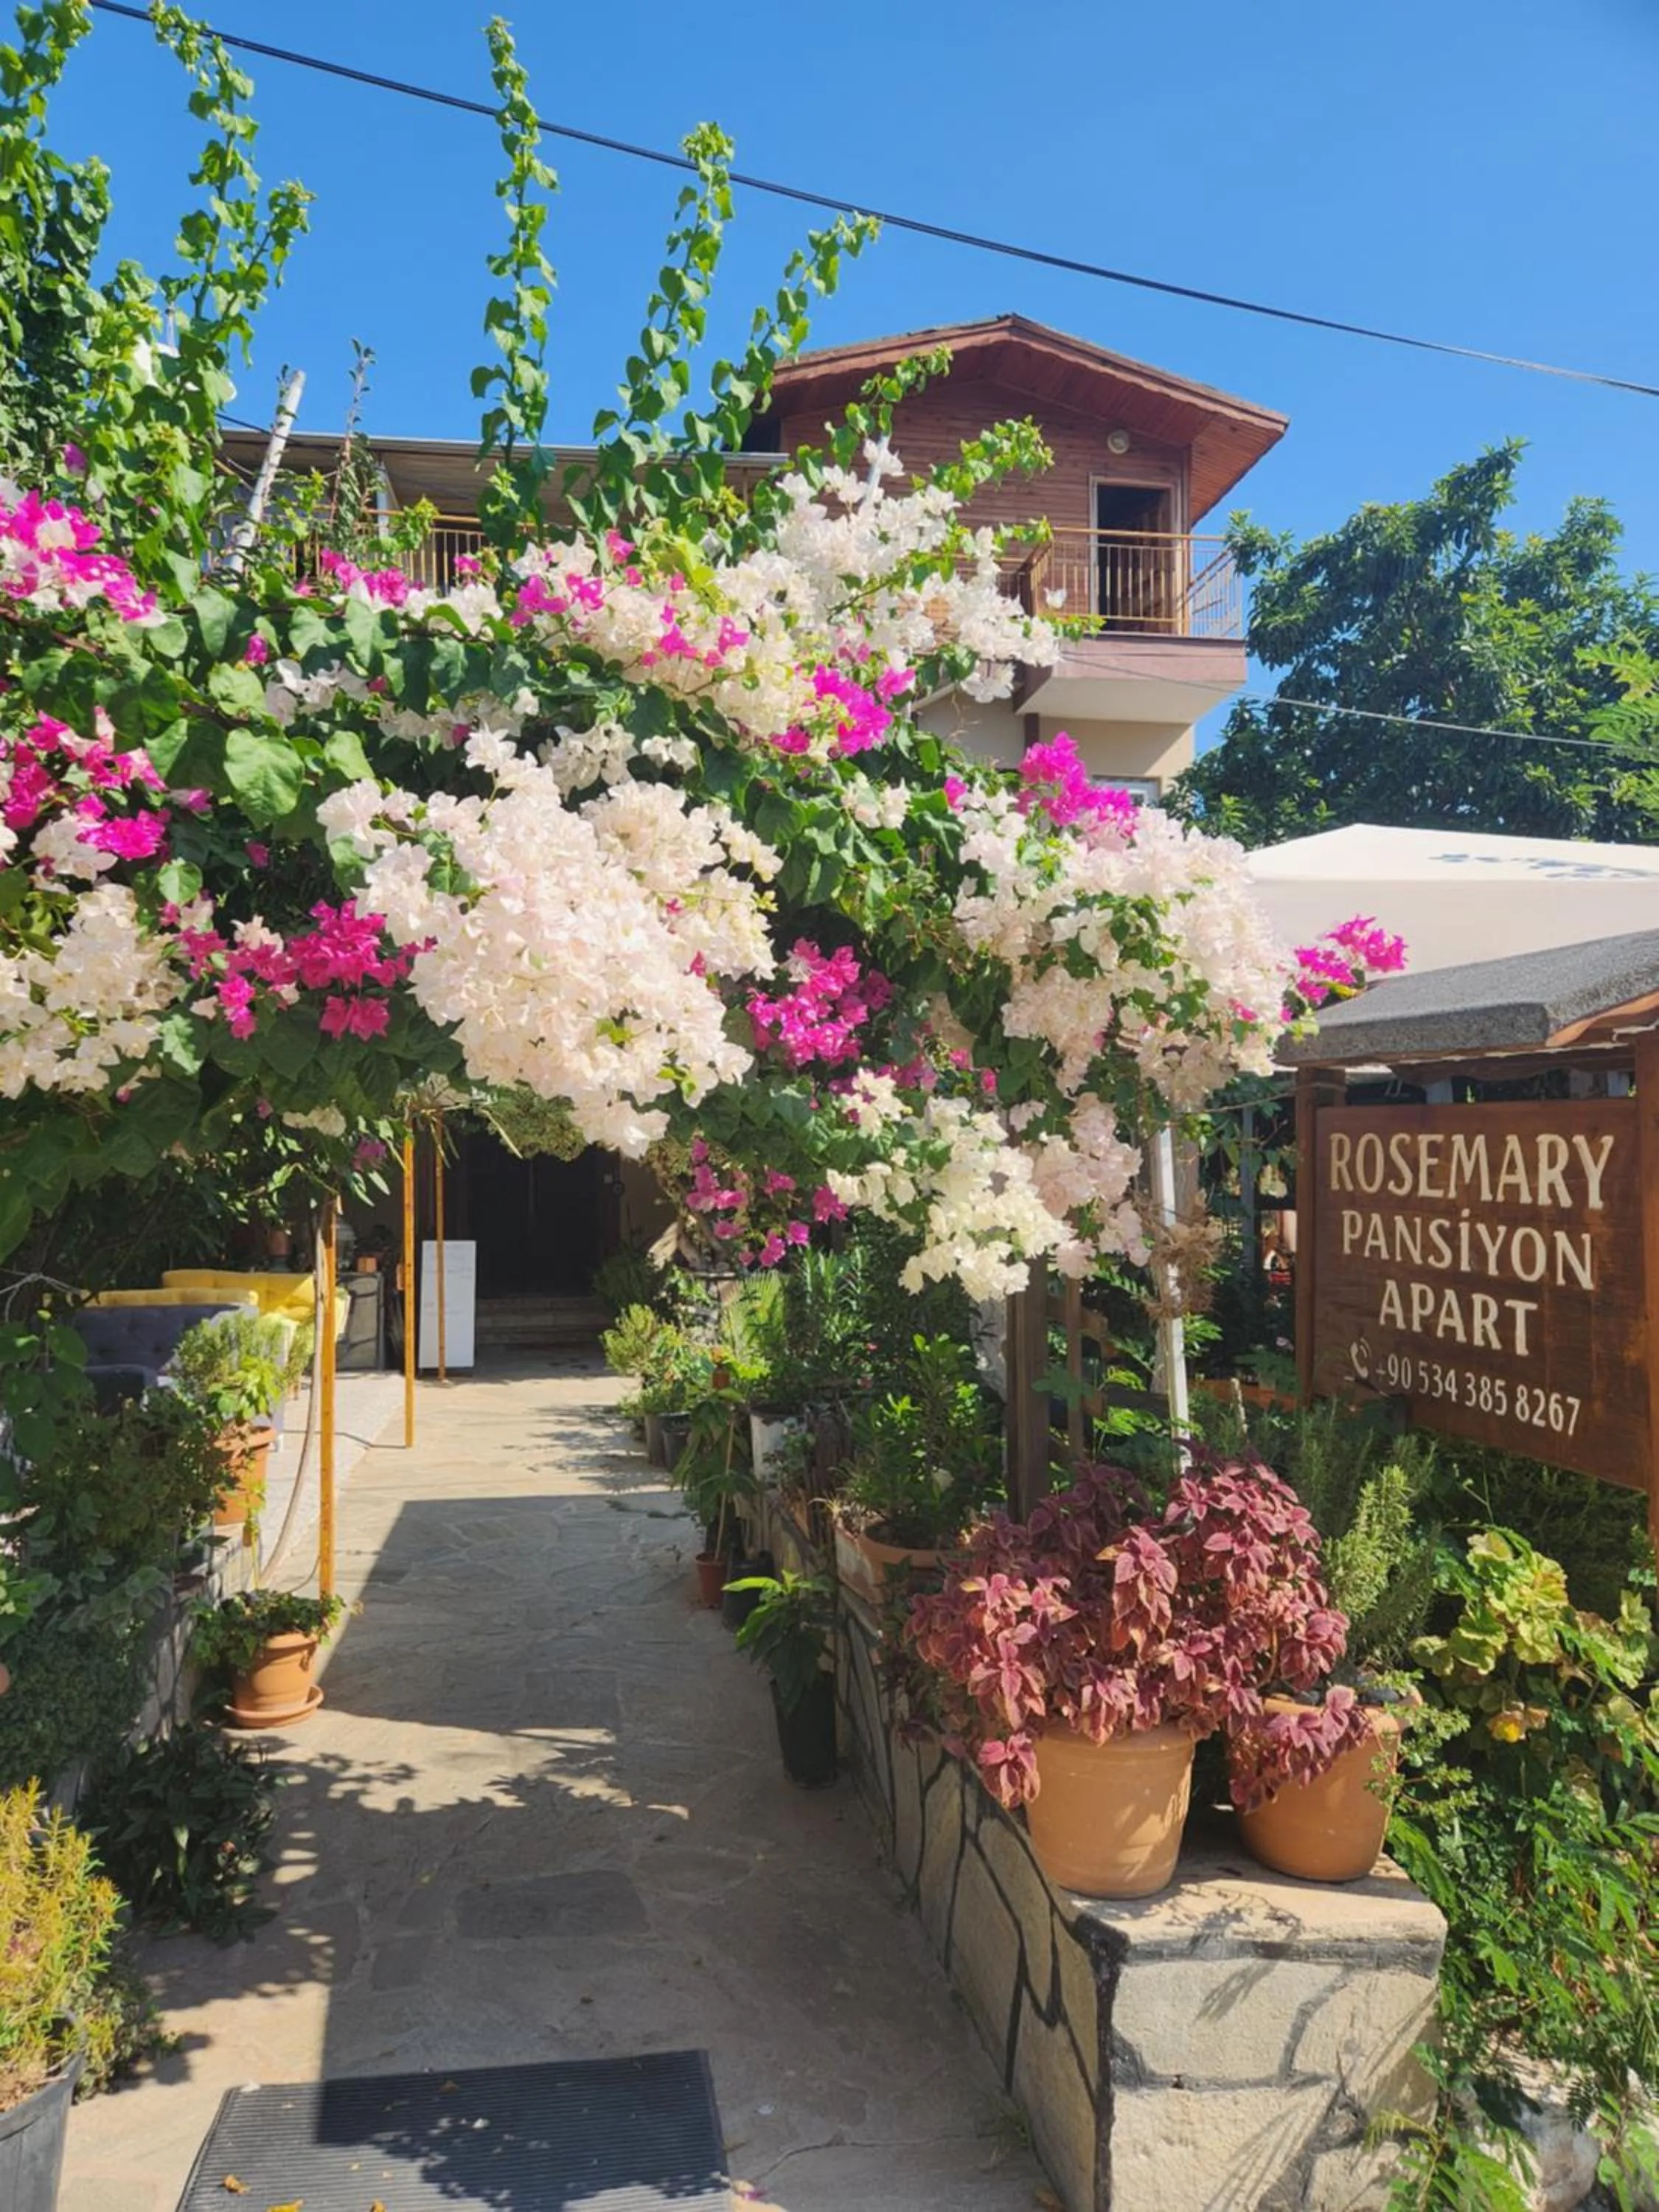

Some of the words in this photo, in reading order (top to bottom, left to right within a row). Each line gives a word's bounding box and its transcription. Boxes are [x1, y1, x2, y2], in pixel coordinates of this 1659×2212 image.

[1329, 1133, 1615, 1209] ROSEMARY
[1342, 1208, 1595, 1290] PANSİYON
[1379, 1279, 1538, 1356] APART
[1419, 1361, 1458, 1402] 534
[1464, 1371, 1509, 1416] 385
[1515, 1384, 1581, 1436] 8267
